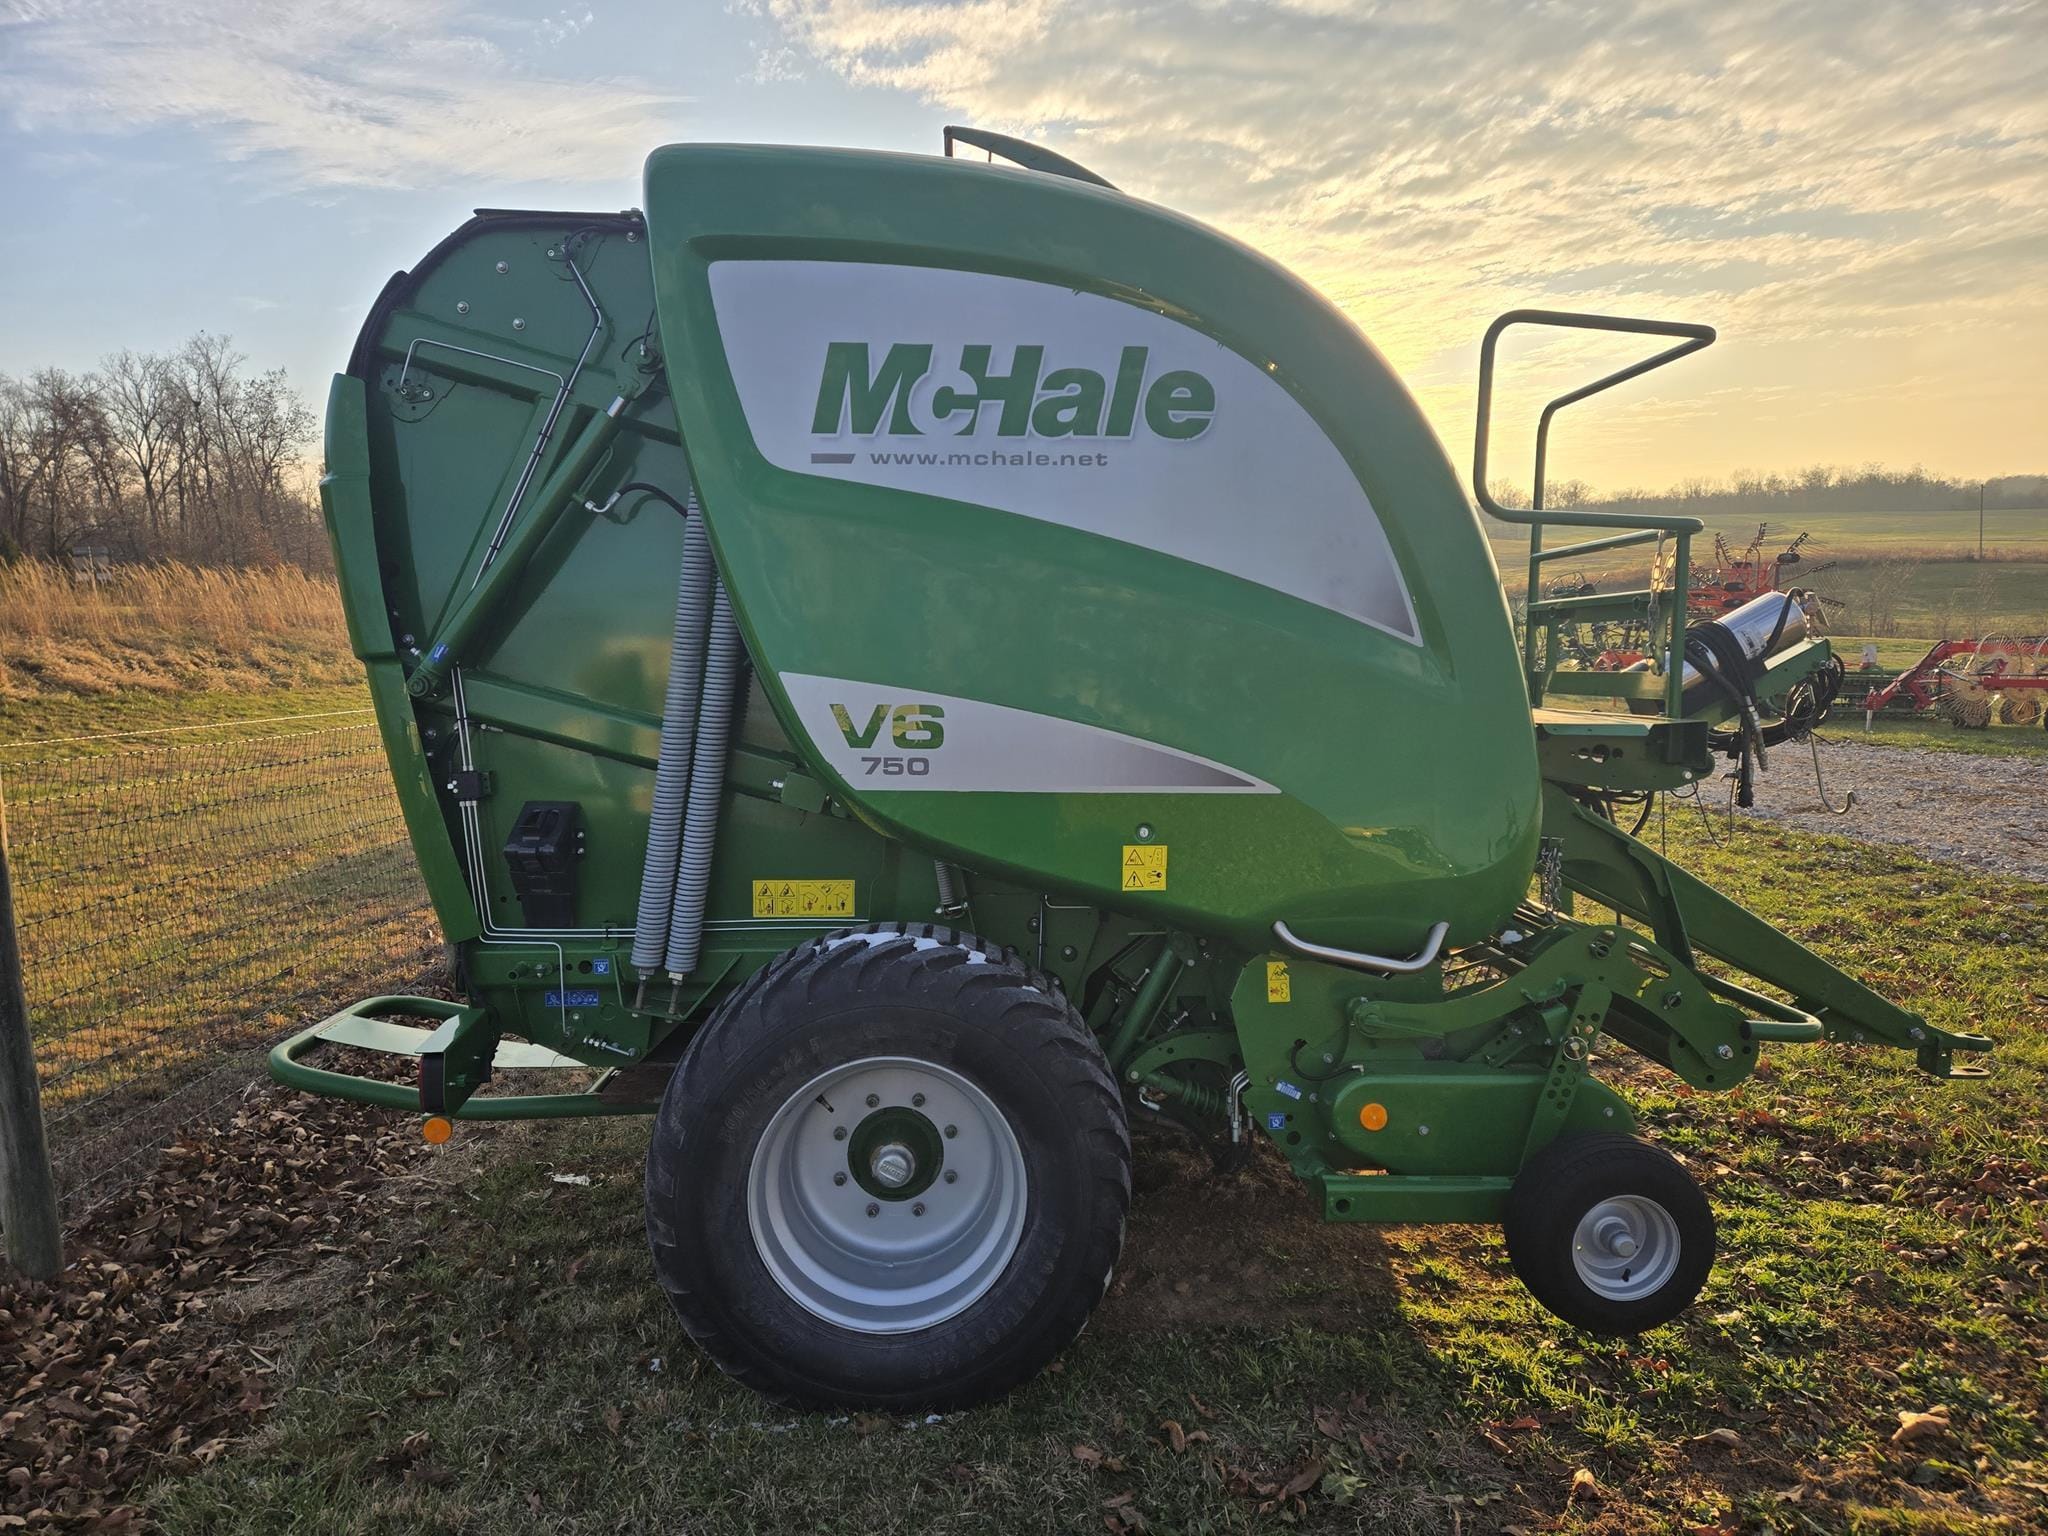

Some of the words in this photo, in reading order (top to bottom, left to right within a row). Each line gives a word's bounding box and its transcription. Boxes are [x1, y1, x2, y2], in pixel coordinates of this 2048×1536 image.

[810, 342, 1216, 441] McHale
[870, 450, 1109, 467] www.mchale.net
[829, 704, 945, 749] V6
[861, 757, 930, 776] 750
